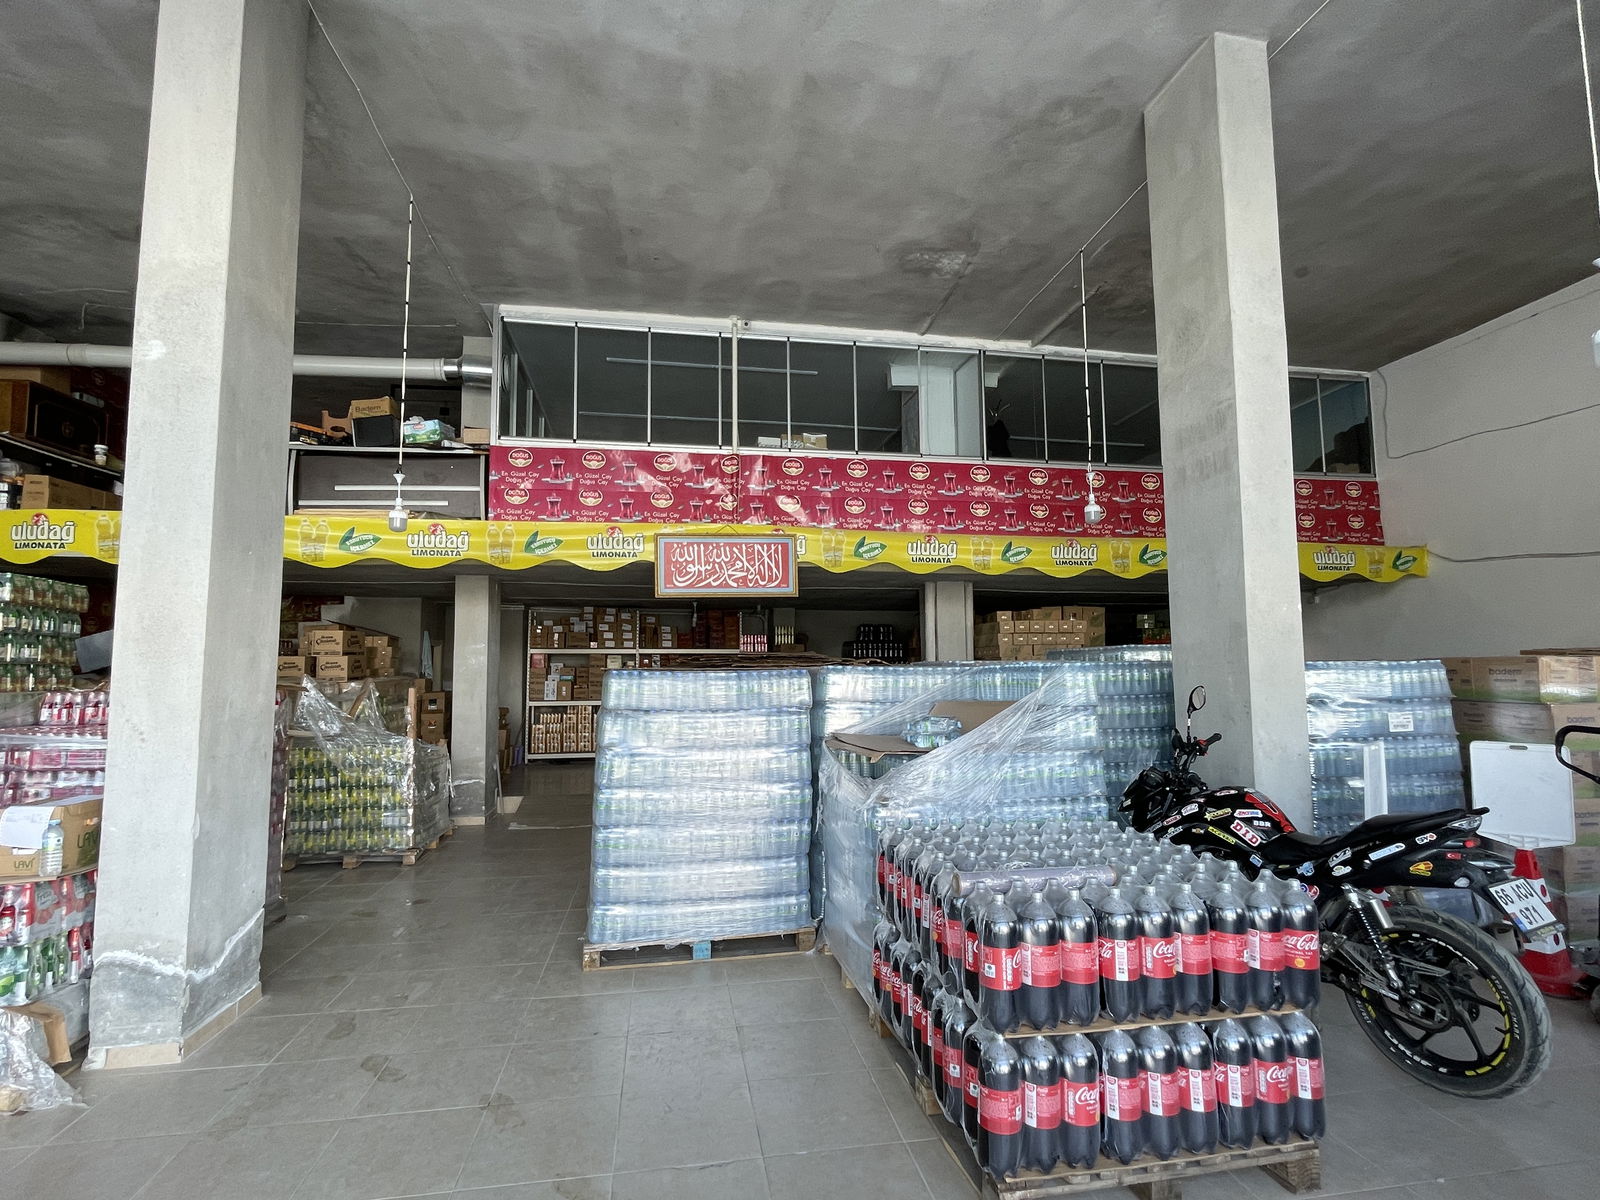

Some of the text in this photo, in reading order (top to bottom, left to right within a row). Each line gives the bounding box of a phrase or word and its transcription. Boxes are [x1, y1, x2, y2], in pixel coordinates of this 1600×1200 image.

[12, 520, 76, 544] uludağ
[407, 530, 470, 551] uludağ
[587, 533, 645, 552] uludağ
[908, 539, 958, 558] uludağ
[1052, 542, 1098, 562] uludağ
[1314, 550, 1356, 566] uludağ
[1494, 882, 1534, 906] 66 ACU
[1519, 905, 1545, 926] 971
